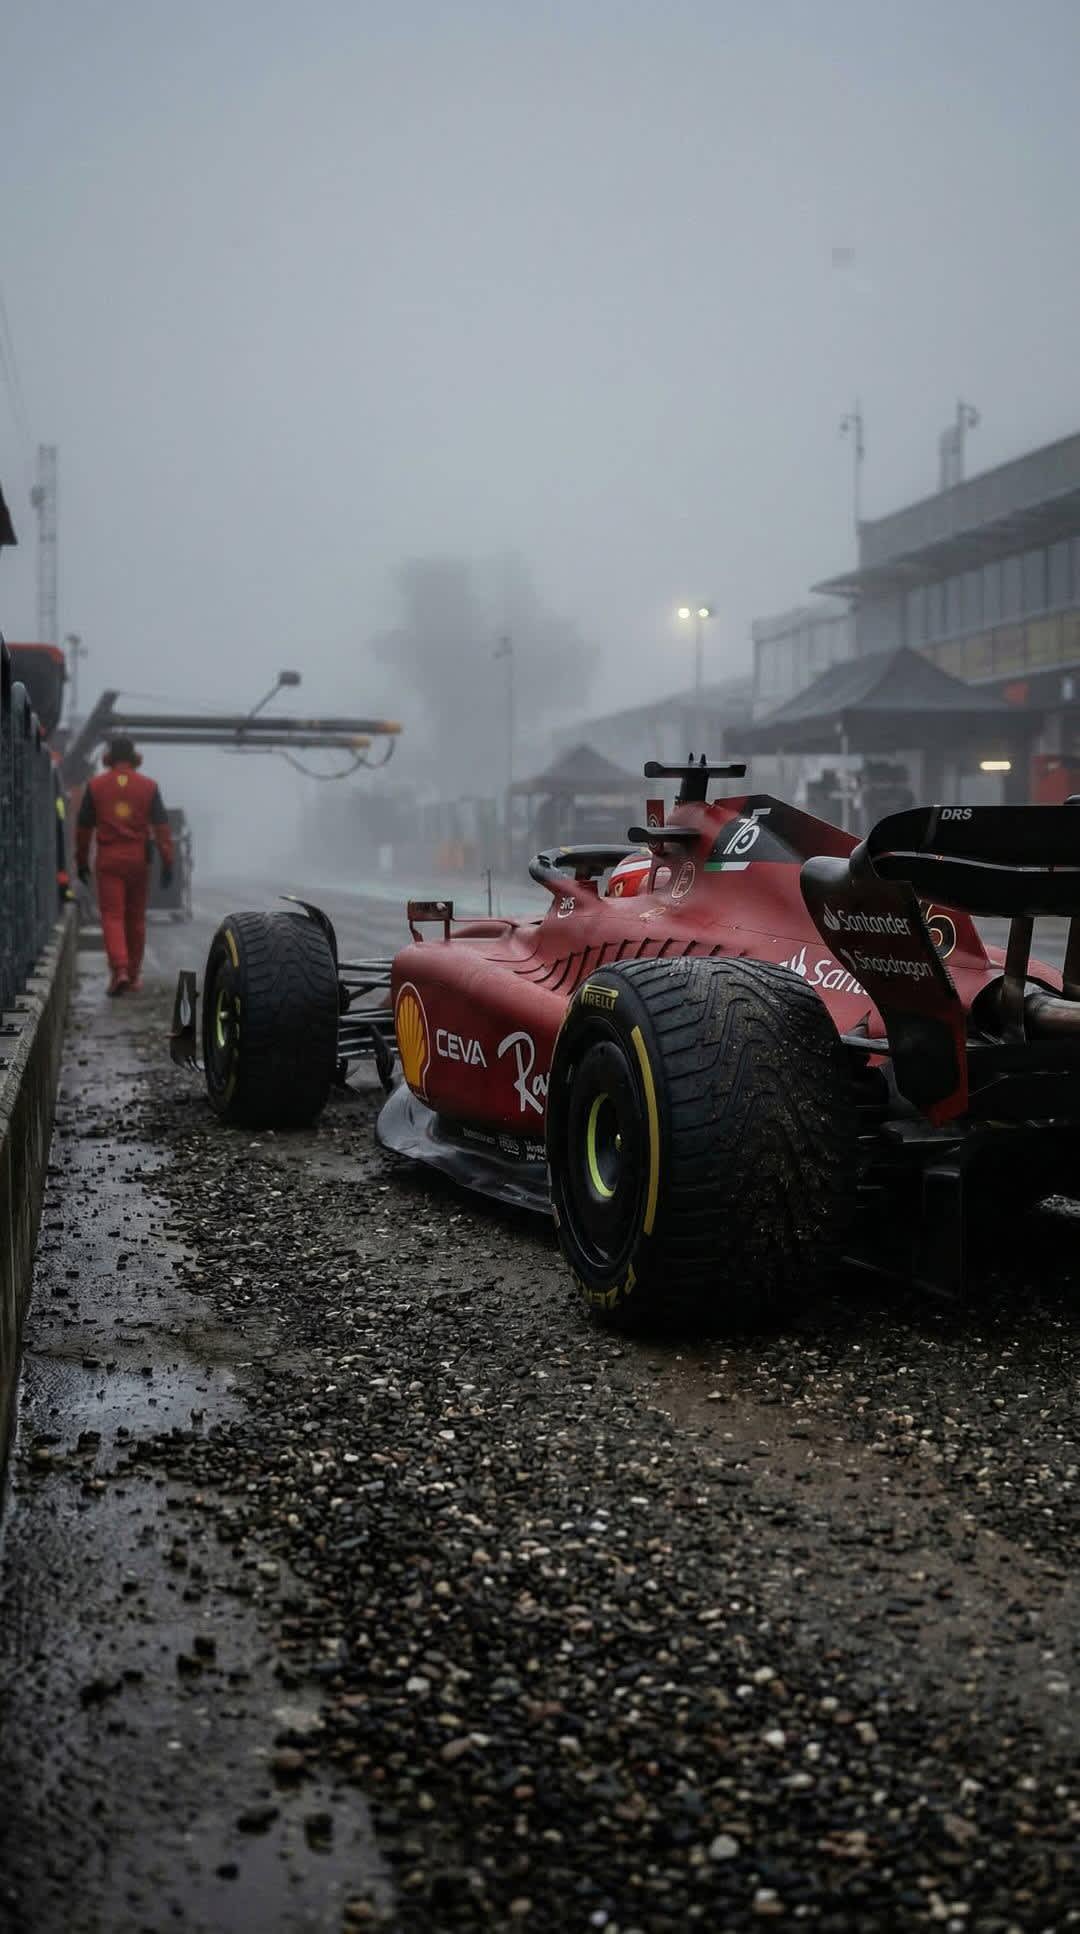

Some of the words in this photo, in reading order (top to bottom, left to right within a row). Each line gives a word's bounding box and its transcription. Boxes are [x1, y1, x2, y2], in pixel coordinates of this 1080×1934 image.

[941, 808, 973, 821] DRS
[837, 910, 911, 936] Santander
[806, 959, 869, 996] San
[854, 951, 934, 981] Snapdragon
[581, 984, 619, 1012] PIRELLI
[436, 1028, 487, 1068] CEVA
[497, 1031, 550, 1114] Ra
